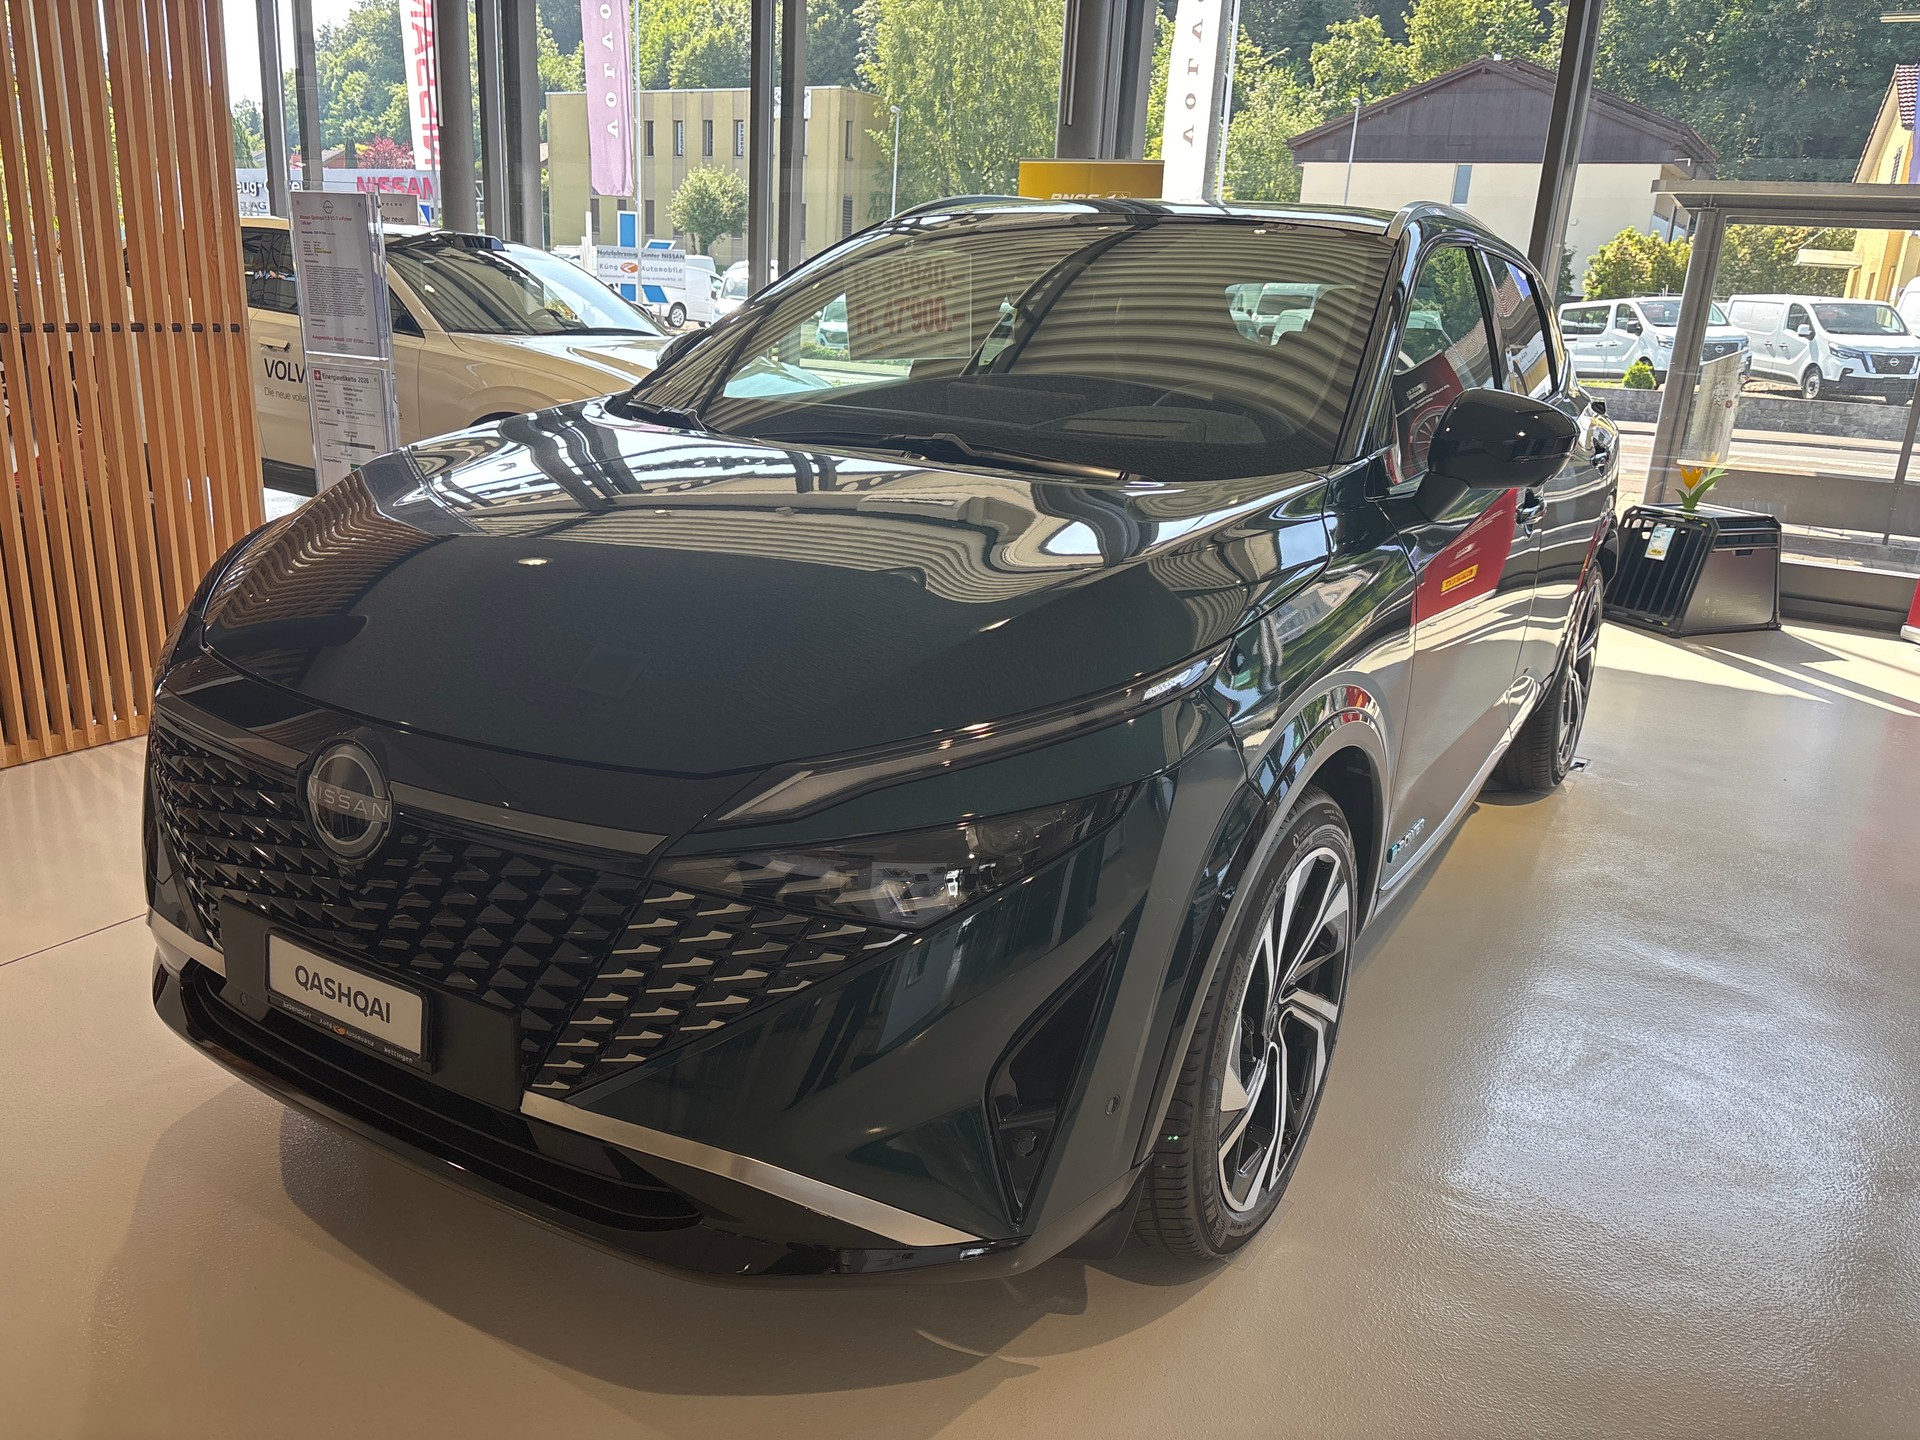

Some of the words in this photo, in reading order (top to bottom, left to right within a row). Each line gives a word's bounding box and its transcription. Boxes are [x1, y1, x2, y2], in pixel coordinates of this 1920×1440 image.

[599, 262, 618, 271] Küng
[641, 265, 683, 274] Automobile
[264, 357, 305, 384] VOLV
[264, 386, 275, 397] Die
[275, 390, 291, 400] neue
[308, 780, 389, 819] NISSAN
[295, 964, 391, 1024] QASHQAI
